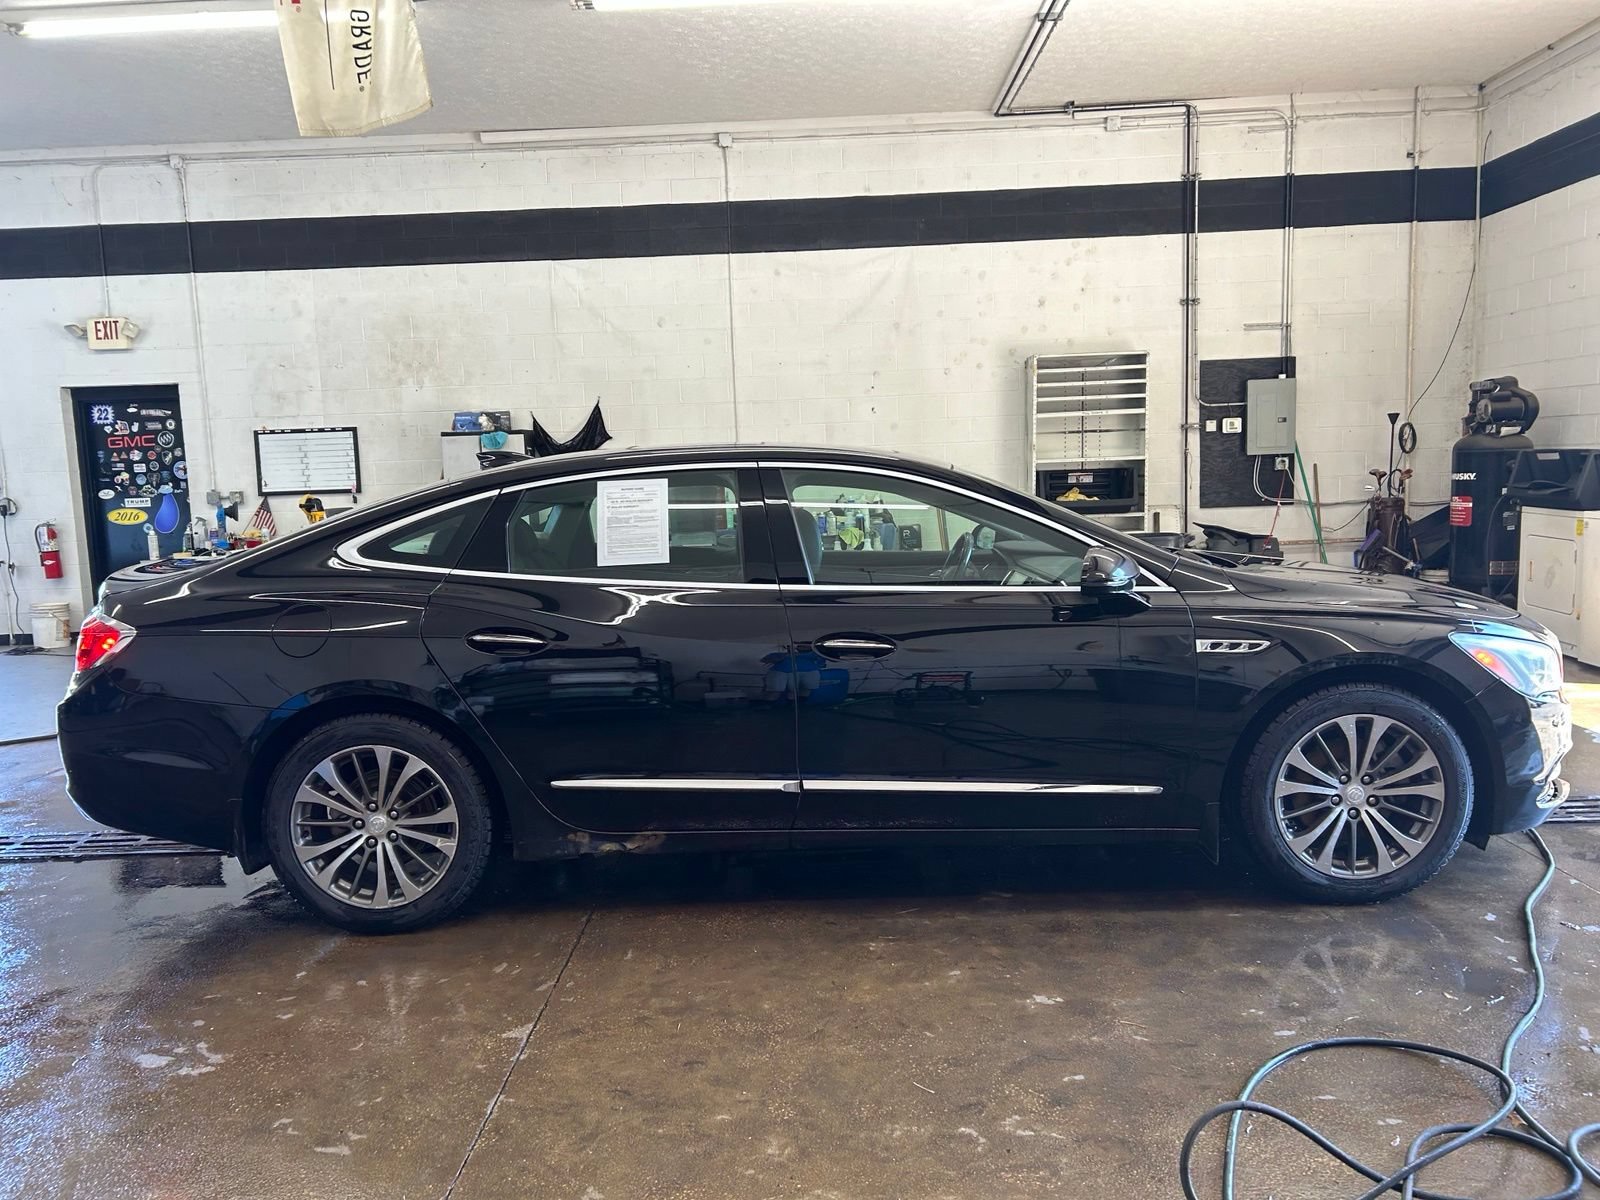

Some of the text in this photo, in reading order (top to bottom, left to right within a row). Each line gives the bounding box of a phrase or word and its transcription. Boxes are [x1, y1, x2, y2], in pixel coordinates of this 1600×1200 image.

[94, 320, 119, 340] EXIT
[96, 407, 110, 421] 22
[107, 435, 156, 448] GMC
[114, 511, 141, 522] 2016
